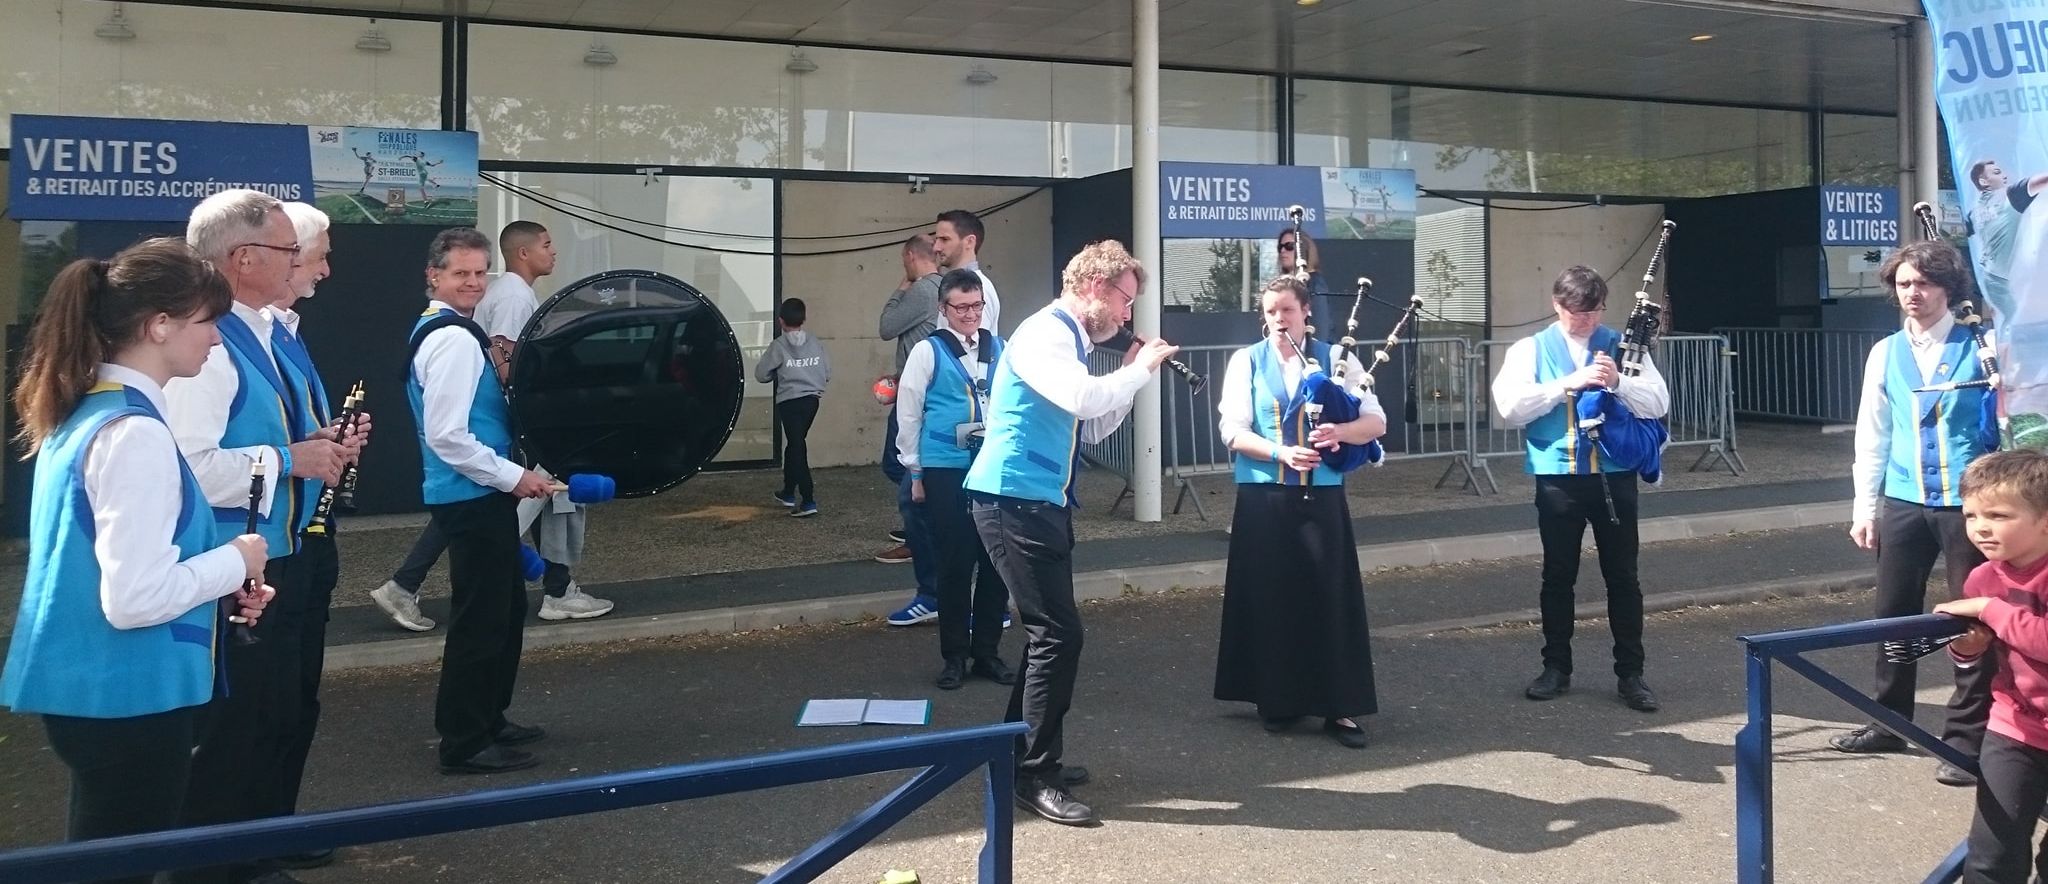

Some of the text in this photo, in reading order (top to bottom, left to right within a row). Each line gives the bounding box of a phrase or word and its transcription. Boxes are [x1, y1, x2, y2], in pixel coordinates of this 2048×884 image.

[24, 138, 177, 174] VENTES
[377, 168, 416, 177] ST-BRIEUC
[26, 177, 41, 195] &
[45, 178, 118, 196] RETRAIT
[121, 180, 155, 197] DES
[1168, 176, 1251, 202] VENTES
[1825, 191, 1883, 214] VENTES
[1168, 205, 1316, 222] & RETRAIT DES INVITATNS
[1826, 219, 1897, 241] & LITIGES
[786, 356, 820, 368] ALEXIS
